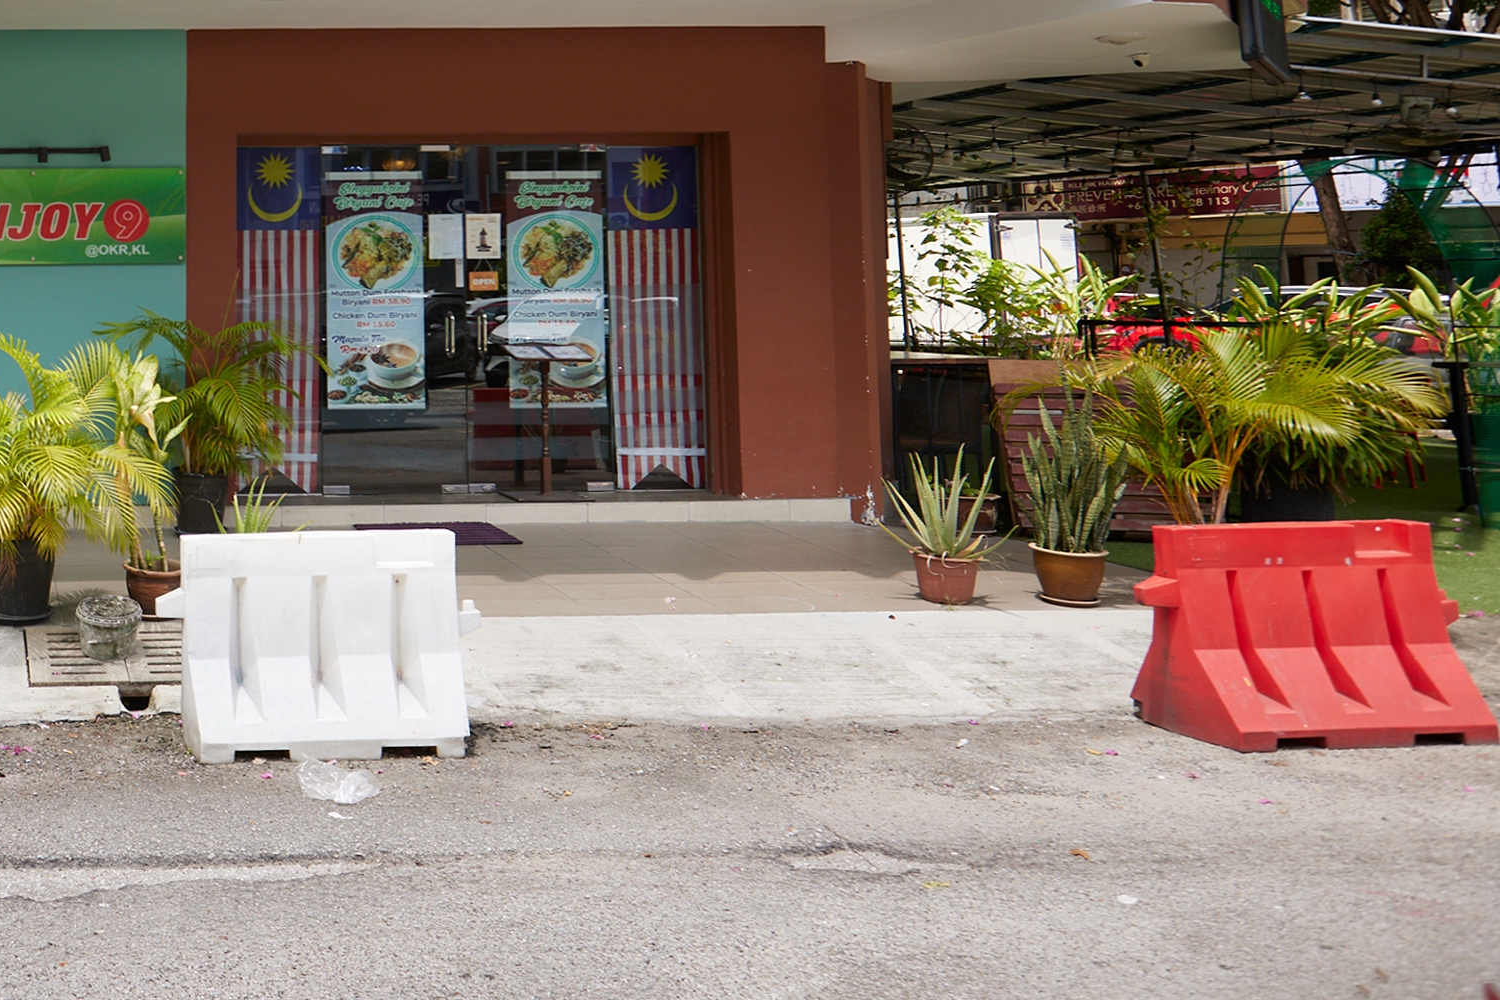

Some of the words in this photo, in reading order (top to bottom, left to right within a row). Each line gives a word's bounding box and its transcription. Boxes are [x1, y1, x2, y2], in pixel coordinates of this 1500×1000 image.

[384, 195, 415, 210] Cafe
[564, 194, 595, 209] Cafe
[112, 202, 144, 241] 9
[84, 244, 150, 258] @OKR,KL
[472, 278, 496, 286] OPEN
[342, 298, 372, 307] Biryani
[388, 297, 412, 305] 38.90
[389, 311, 418, 320] Biryani
[513, 310, 546, 318] Chicken
[570, 309, 599, 319] Biryani
[331, 335, 369, 344] Masala
[371, 334, 386, 343] Tea
